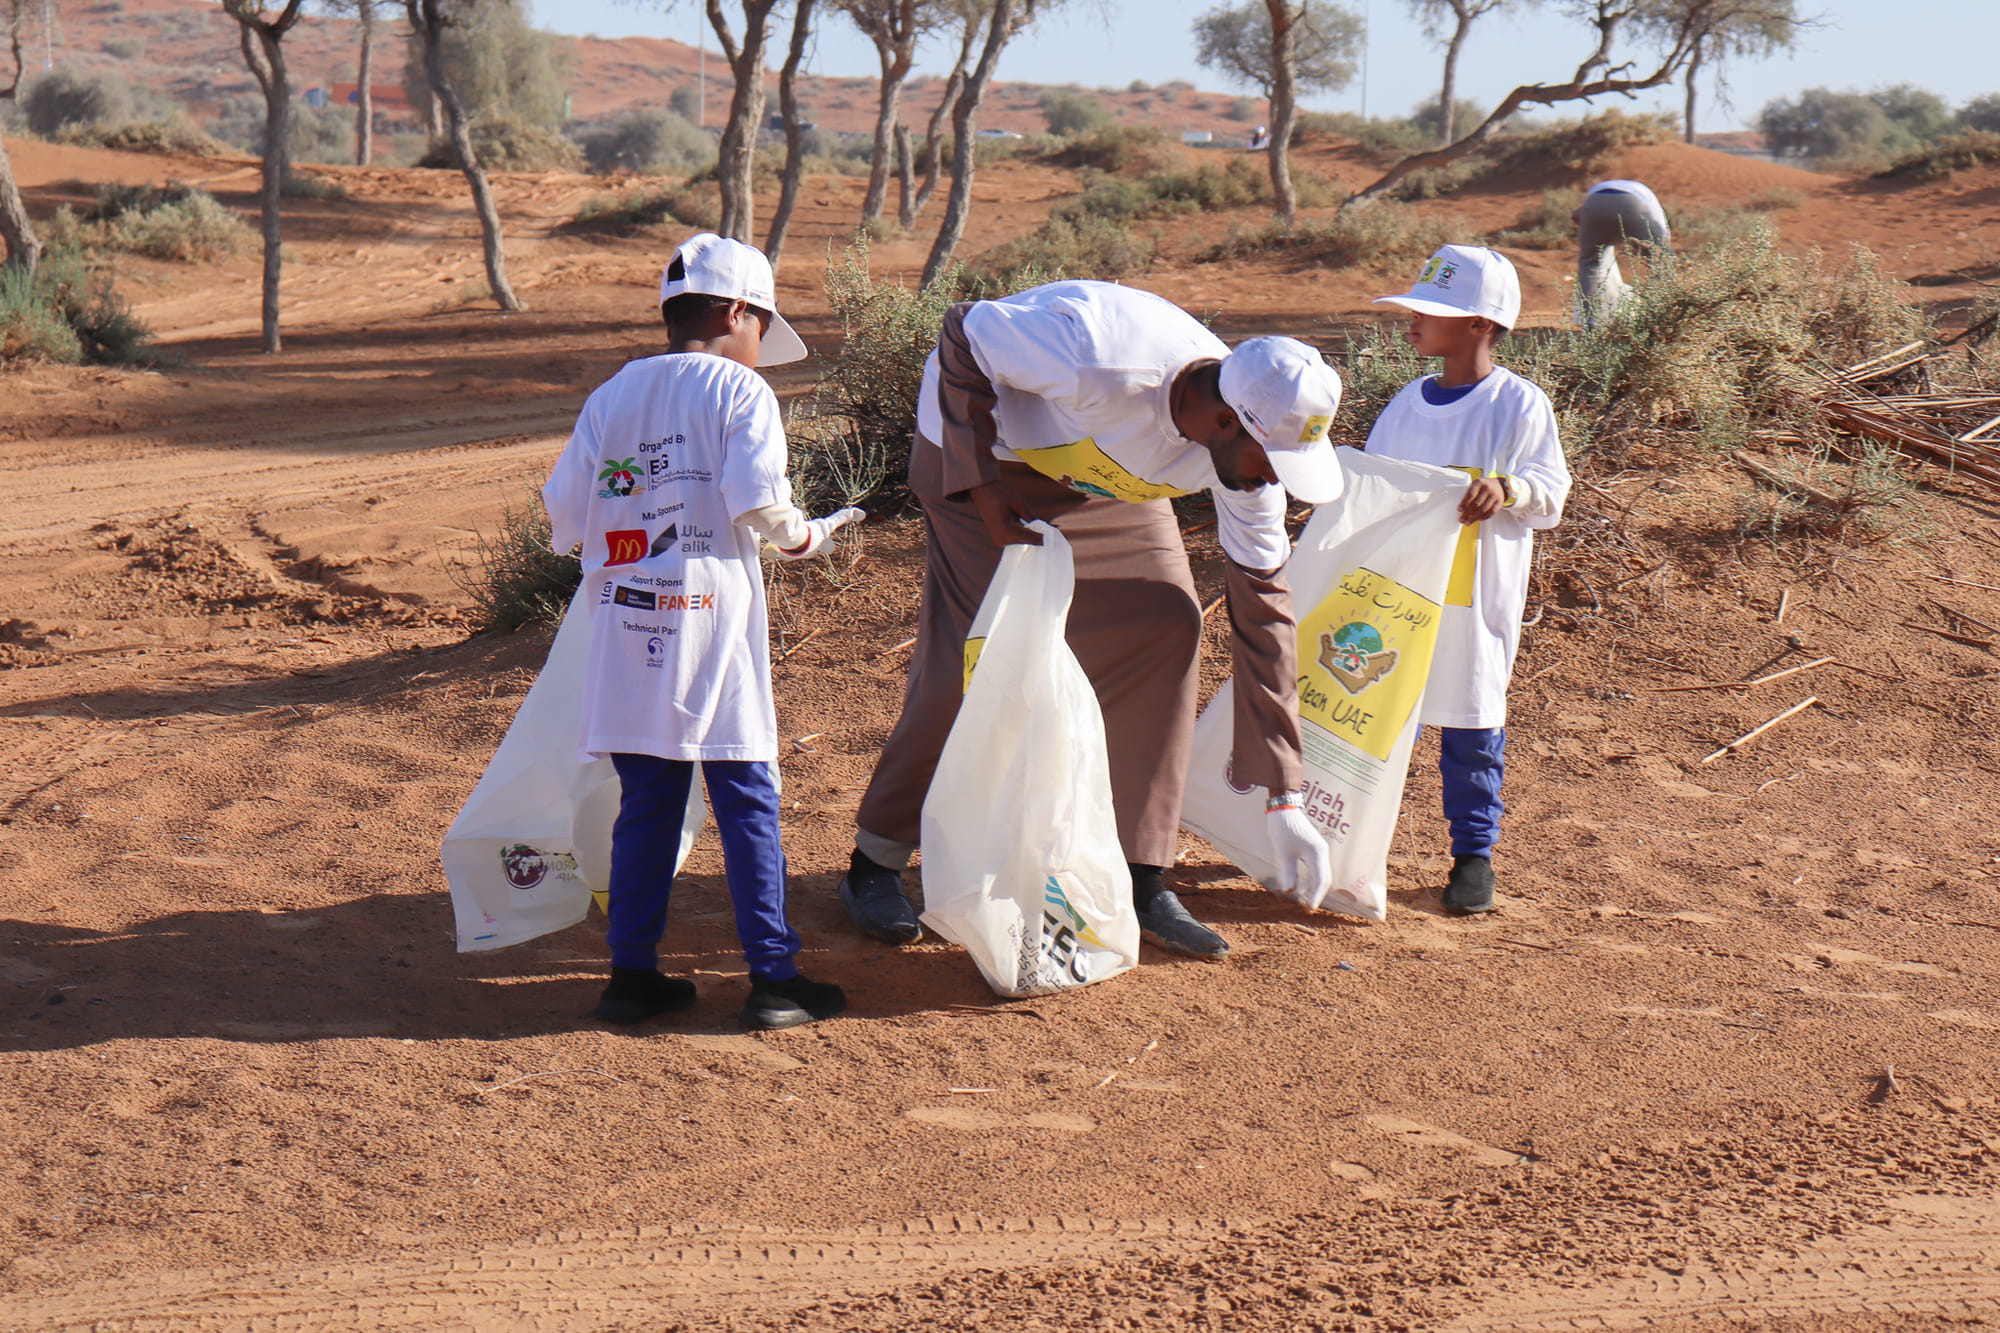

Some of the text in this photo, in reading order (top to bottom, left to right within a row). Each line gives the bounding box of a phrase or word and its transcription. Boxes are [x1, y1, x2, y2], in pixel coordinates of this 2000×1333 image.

[681, 540, 711, 553] alik
[655, 577, 684, 588] Spons
[622, 620, 660, 634] Technical
[1332, 699, 1374, 735] UAE
[1300, 780, 1345, 812] ajrah
[1307, 804, 1352, 836] astic
